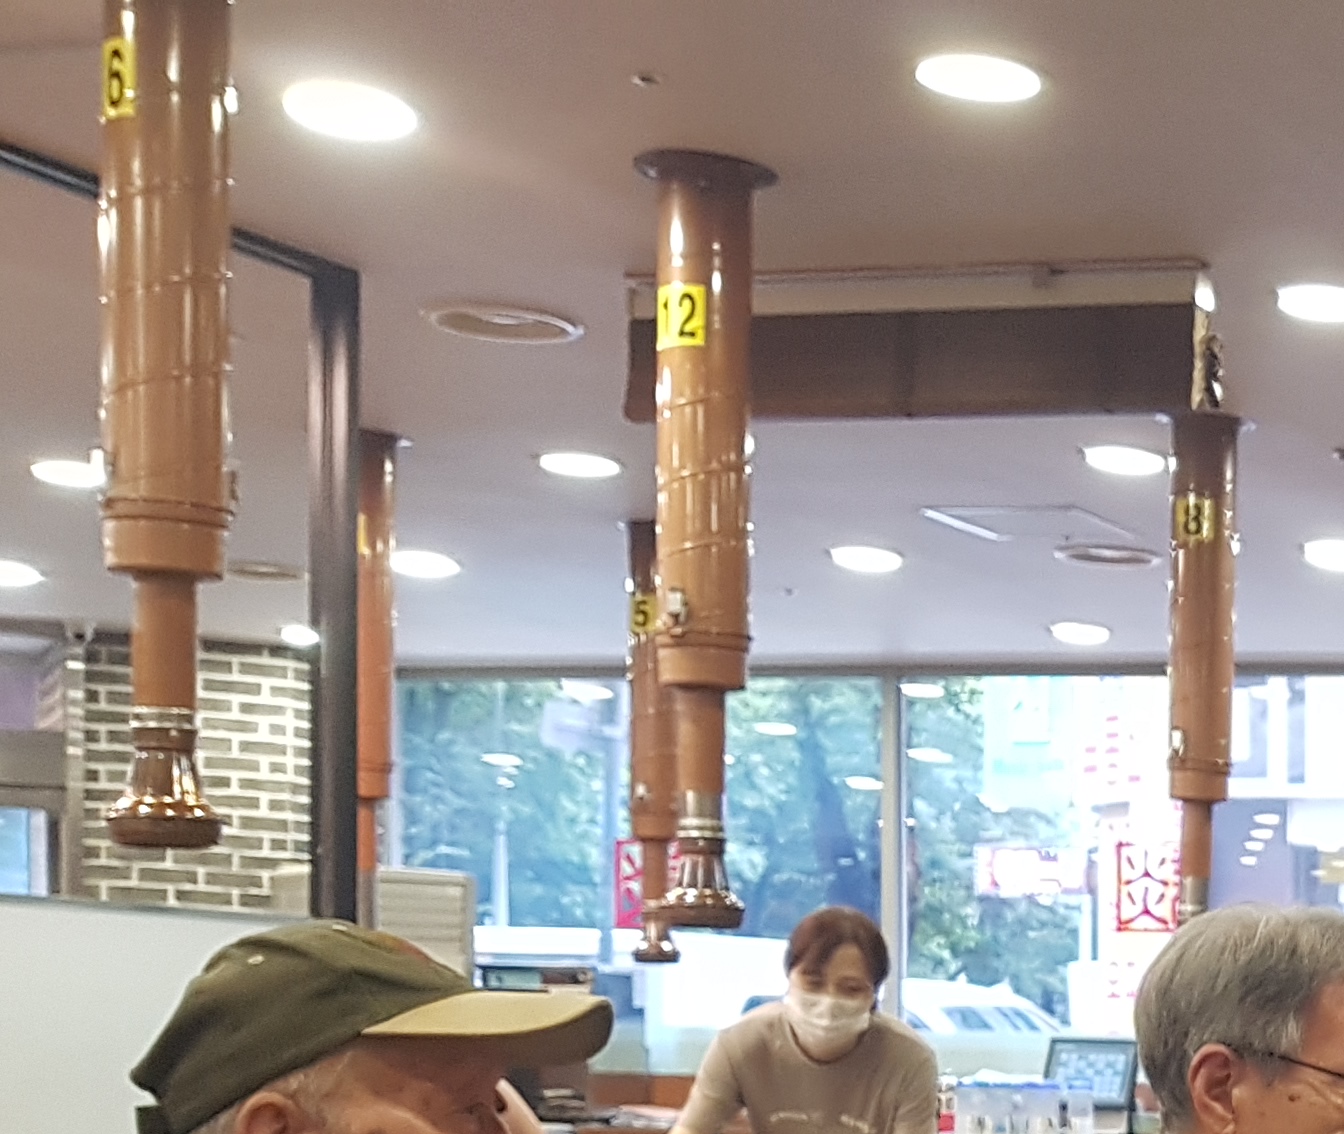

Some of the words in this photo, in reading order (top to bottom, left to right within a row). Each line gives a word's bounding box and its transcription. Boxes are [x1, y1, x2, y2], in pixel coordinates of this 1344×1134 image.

[108, 48, 123, 108] 6
[662, 292, 696, 338] 12
[1183, 502, 1201, 536] 8
